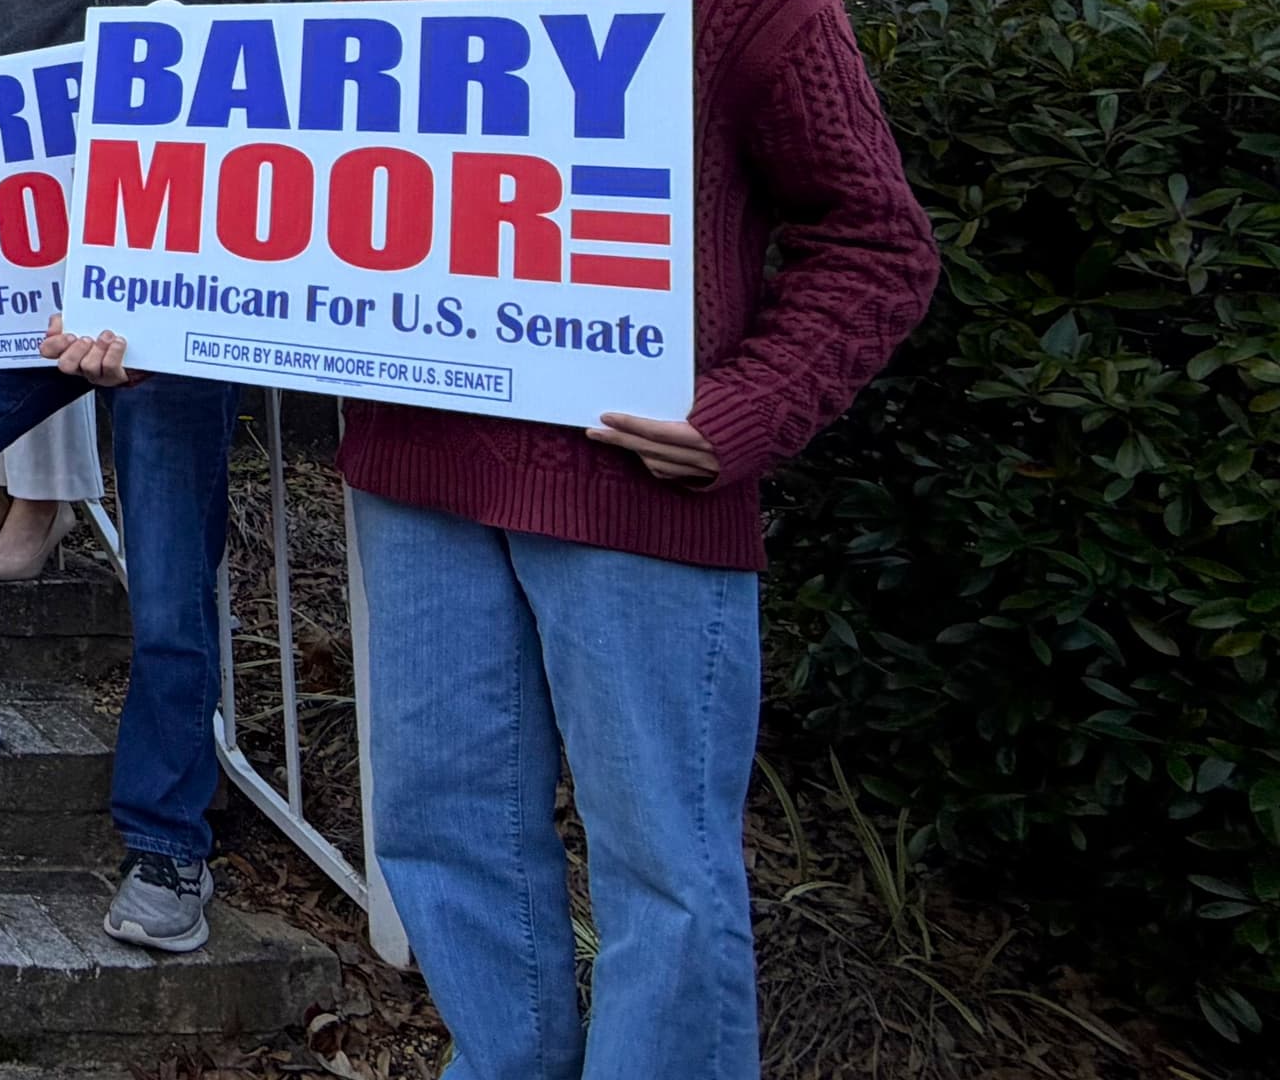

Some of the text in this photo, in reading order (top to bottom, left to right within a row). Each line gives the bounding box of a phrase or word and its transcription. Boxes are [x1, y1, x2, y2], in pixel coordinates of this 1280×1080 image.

[92, 12, 665, 139] BARRY
[82, 139, 671, 291] MOORE
[82, 264, 289, 319] Republican
[306, 285, 375, 327] For
[392, 293, 476, 339] U.S.
[496, 302, 664, 358] Senate
[192, 341, 503, 392] PAID FOR BY BARRY MOORE FOR U.S. SENATE
